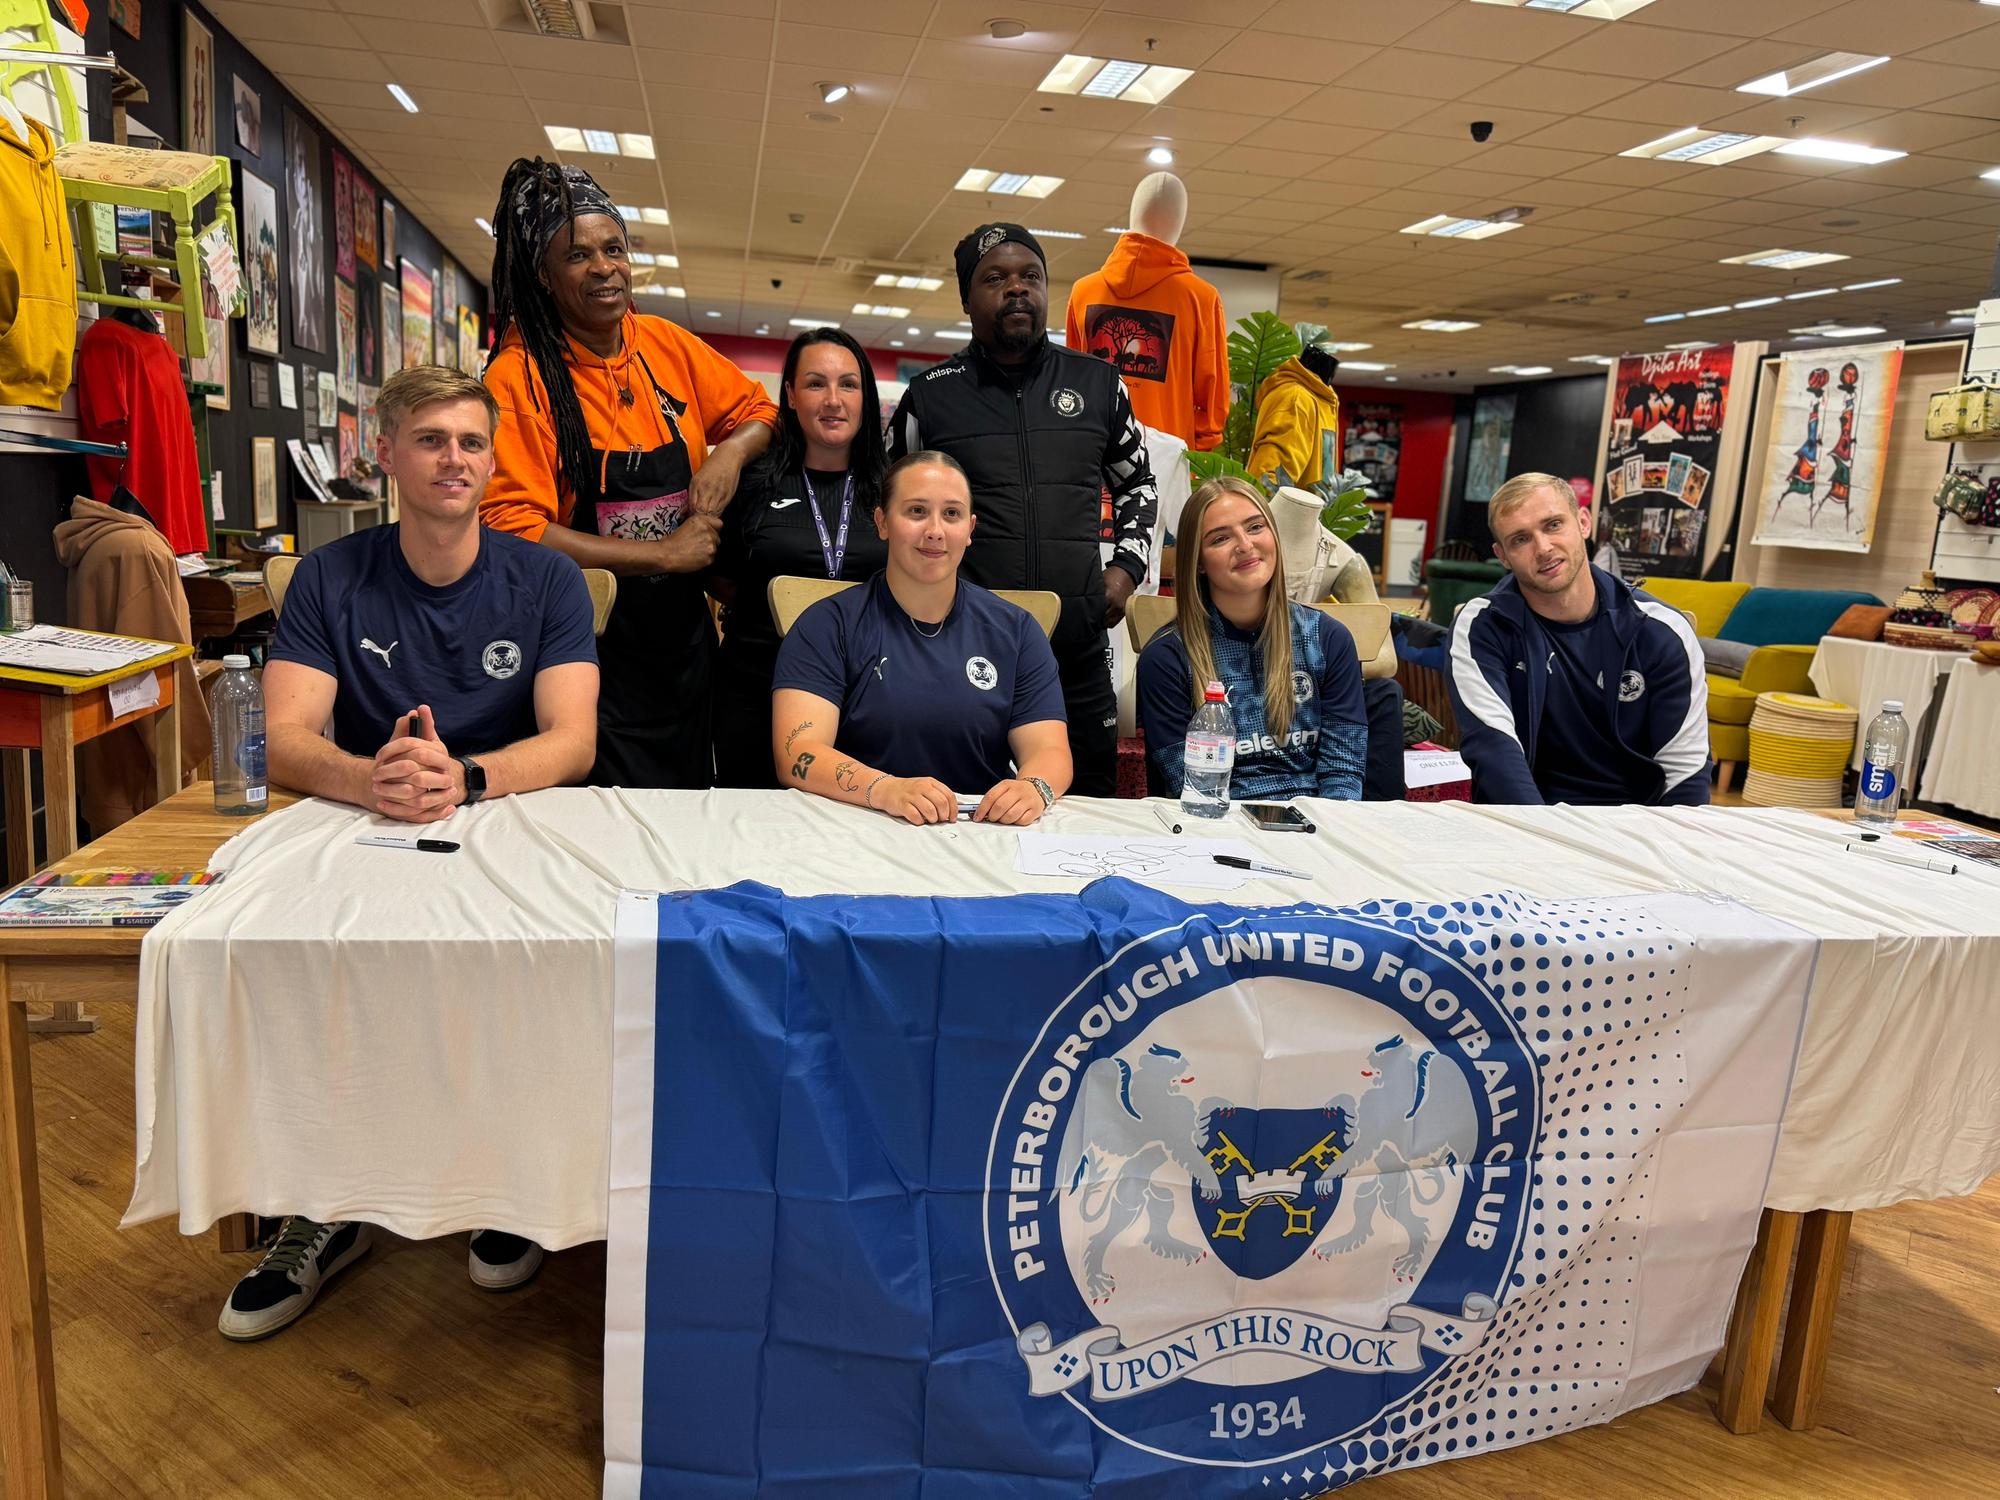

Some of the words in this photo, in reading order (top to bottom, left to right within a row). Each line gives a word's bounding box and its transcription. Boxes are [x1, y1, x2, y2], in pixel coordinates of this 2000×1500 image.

[925, 364, 967, 381] uhlsport
[1641, 353, 1675, 382] Djibo
[1676, 349, 1703, 373] Art
[1235, 730, 1319, 755] eleven
[1888, 744, 1897, 767] water
[791, 752, 816, 780] 23
[1869, 742, 1889, 793] smart
[1008, 946, 1200, 1282] PETERBOROUGH
[1202, 931, 1365, 971] UNITED
[1372, 951, 1518, 1137] FOOTBALL
[1465, 1142, 1515, 1251] CLUB
[1100, 1335, 1199, 1392] UPON
[1204, 1315, 1293, 1352] THIS
[1300, 1323, 1398, 1368] ROCK
[1209, 1396, 1306, 1439] 1934
